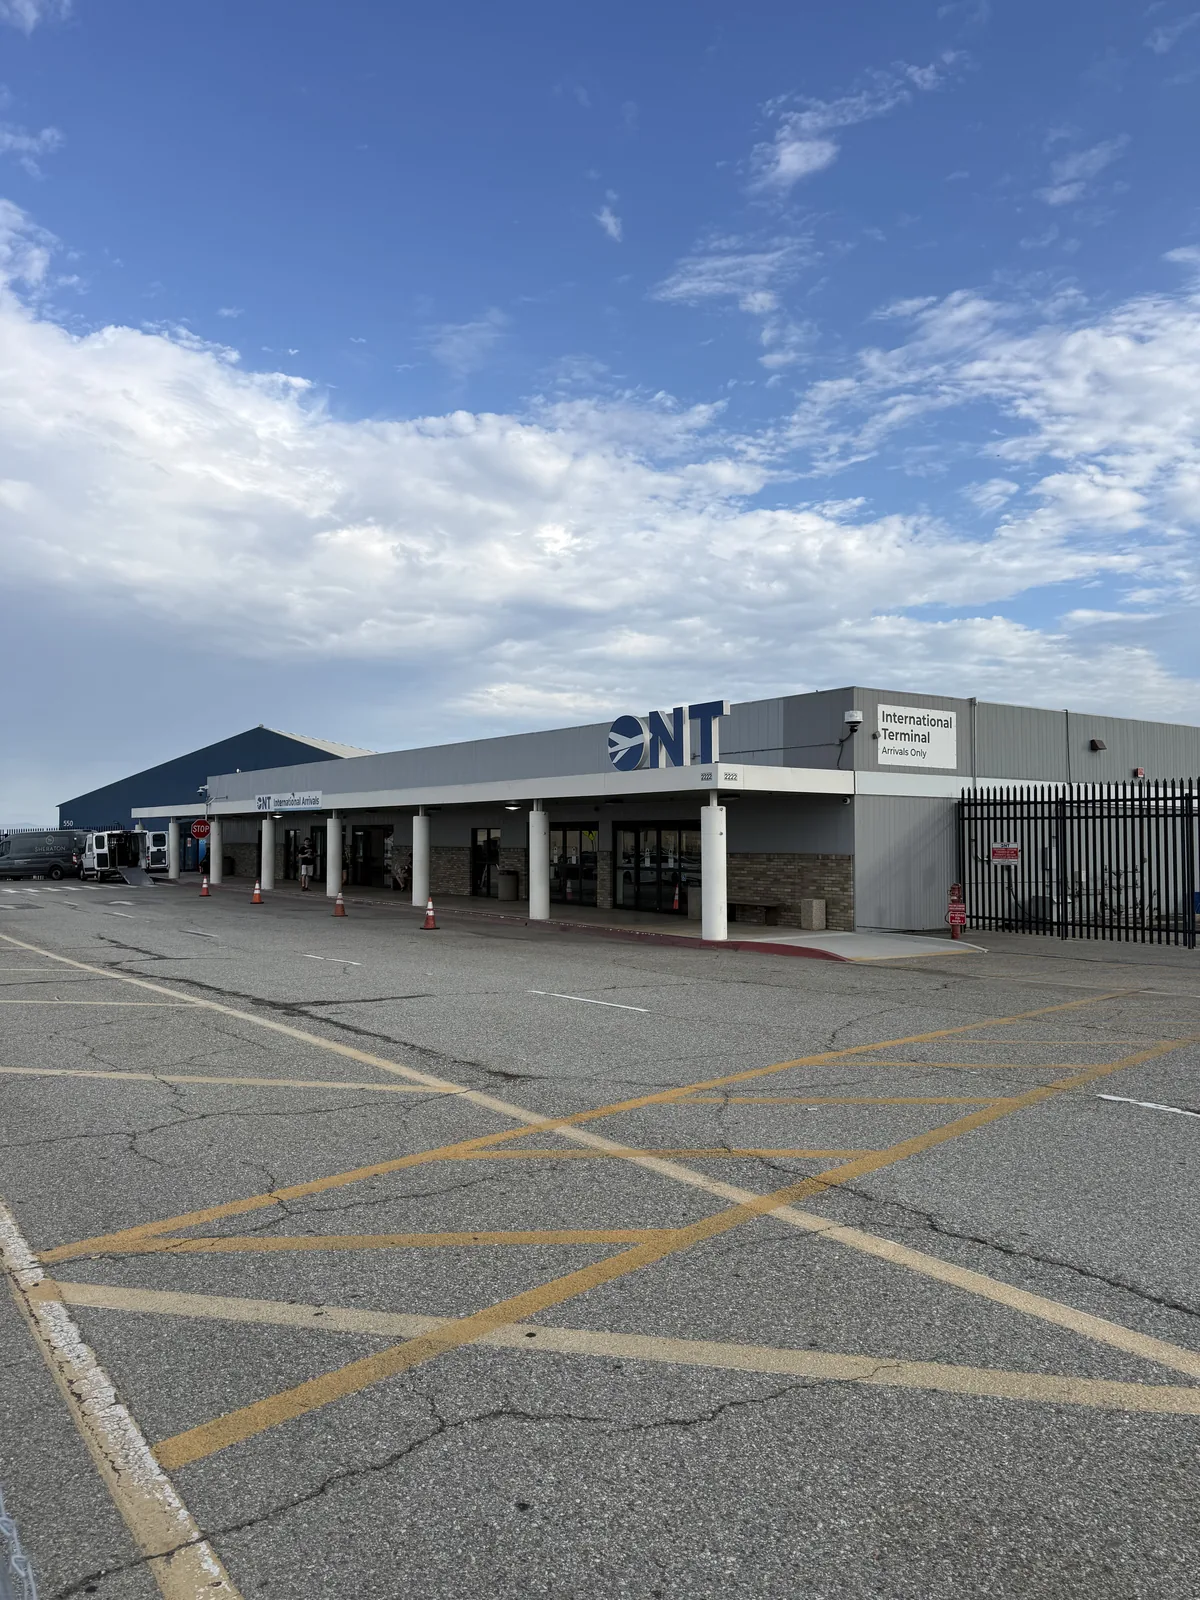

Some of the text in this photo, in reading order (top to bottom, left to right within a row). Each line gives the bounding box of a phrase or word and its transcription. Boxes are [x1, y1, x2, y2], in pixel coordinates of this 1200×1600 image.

[882, 711, 952, 728] International
[608, 699, 731, 771] ONT
[881, 728, 930, 743] Terminal
[882, 746, 927, 759] Arrivals Only
[701, 772, 712, 781] 2222
[724, 772, 738, 781] 2222
[274, 796, 301, 807] International
[302, 796, 319, 806] Arrivals
[192, 825, 210, 833] STOP
